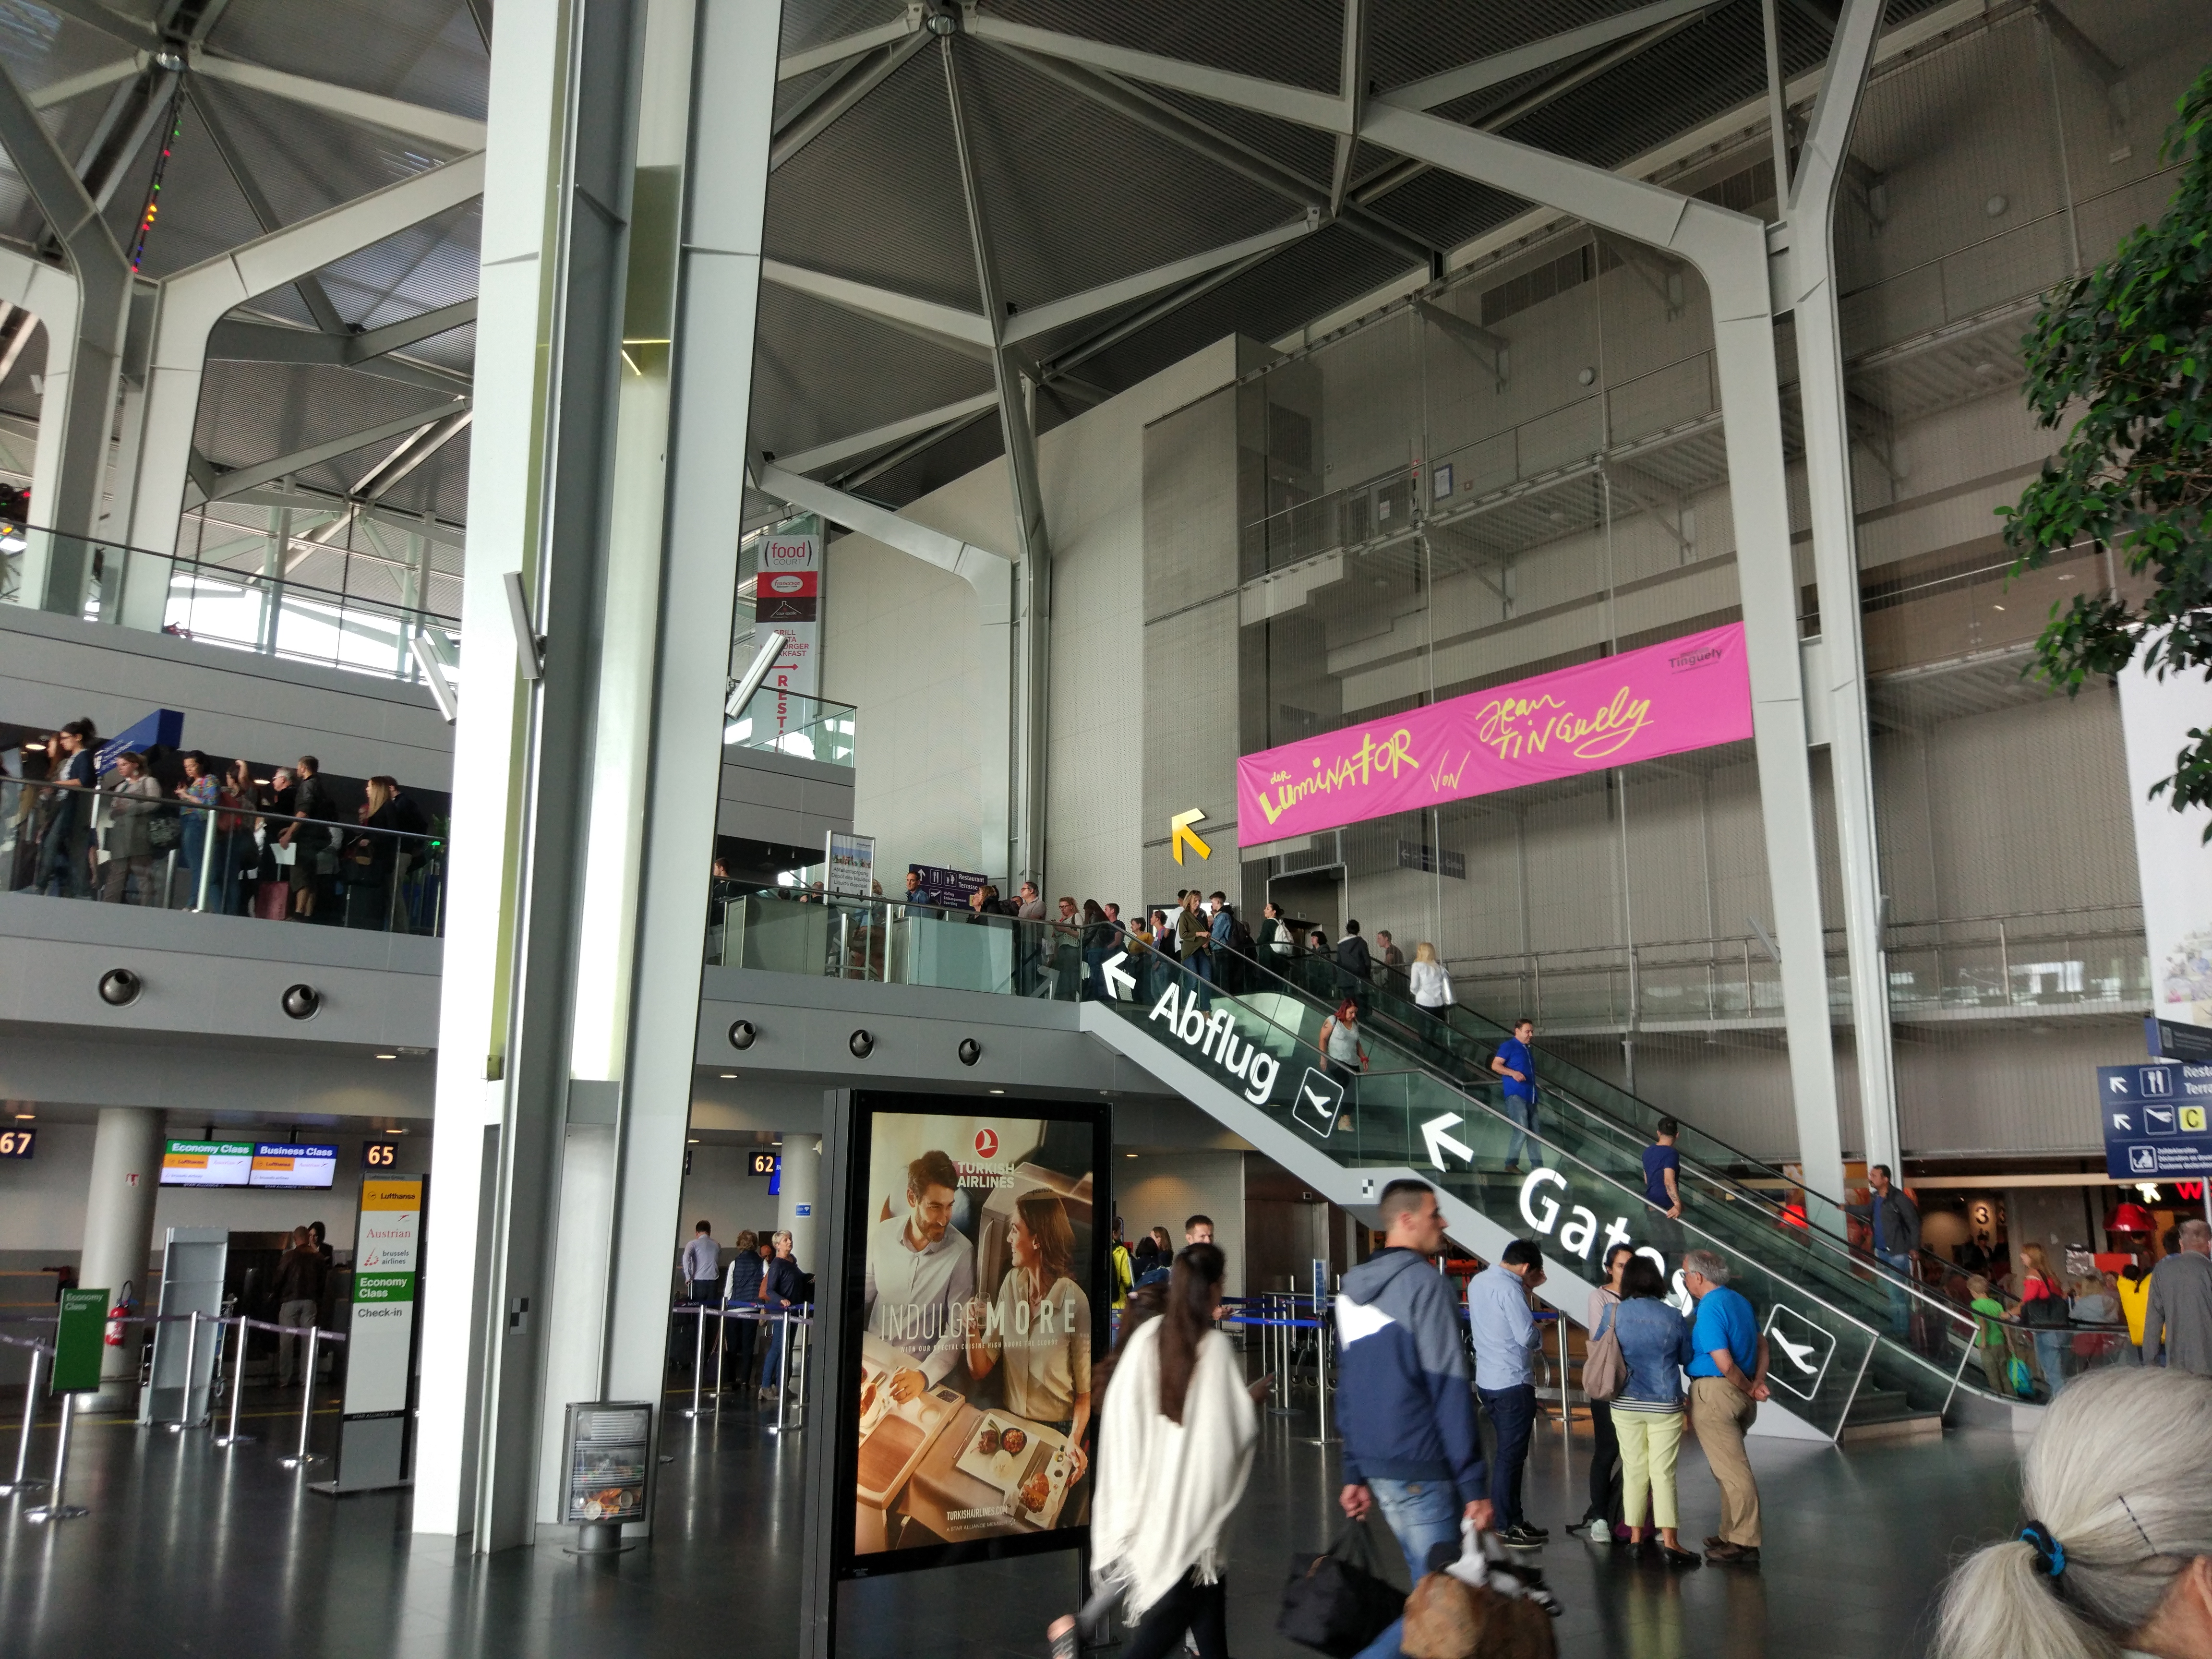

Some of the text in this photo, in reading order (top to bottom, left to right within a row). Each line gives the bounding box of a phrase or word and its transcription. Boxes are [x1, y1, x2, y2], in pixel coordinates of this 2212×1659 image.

[1669, 649, 1722, 668] Tinguely
[959, 874, 985, 883] Restaurant
[958, 882, 978, 890] Terrasse
[1149, 982, 1280, 1105] Abflug
[2186, 1109, 2199, 1128] C
[0, 1132, 32, 1154] 67
[171, 1142, 250, 1154] Economy Class
[260, 1146, 333, 1156] Business Class
[368, 1145, 394, 1165] 65
[755, 1155, 774, 1172] 62
[958, 1162, 1015, 1175] TURKISH
[957, 1175, 1014, 1188] AIRLINES
[1975, 1206, 1989, 1225] 3
[366, 1228, 411, 1238] Austrian
[360, 1277, 408, 1288] Economy
[359, 1288, 388, 1298] Class
[358, 1308, 402, 1318] Check-in
[881, 1299, 1076, 1341] INDULGE MORE
[947, 1504, 1008, 1521] TURKISHAIRLINES.COM
